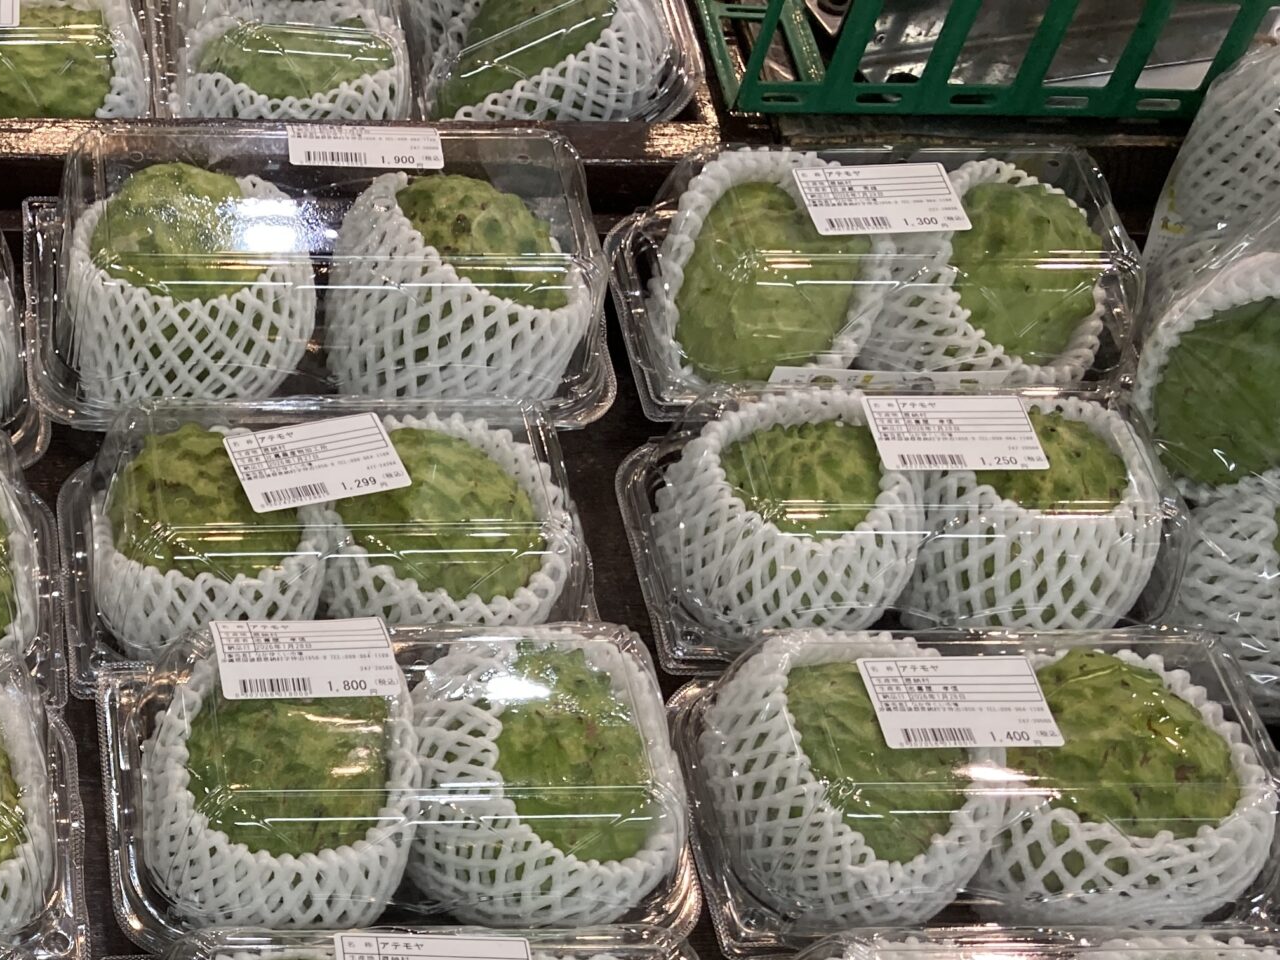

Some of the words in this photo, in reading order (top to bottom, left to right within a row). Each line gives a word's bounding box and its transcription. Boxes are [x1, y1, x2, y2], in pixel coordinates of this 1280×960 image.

[381, 155, 415, 164] 1,900
[901, 217, 940, 227] 1,300
[978, 456, 1018, 466] 1,250
[339, 476, 379, 492] 1,299
[326, 679, 369, 690] 1,800
[988, 731, 1031, 743] 1,400
